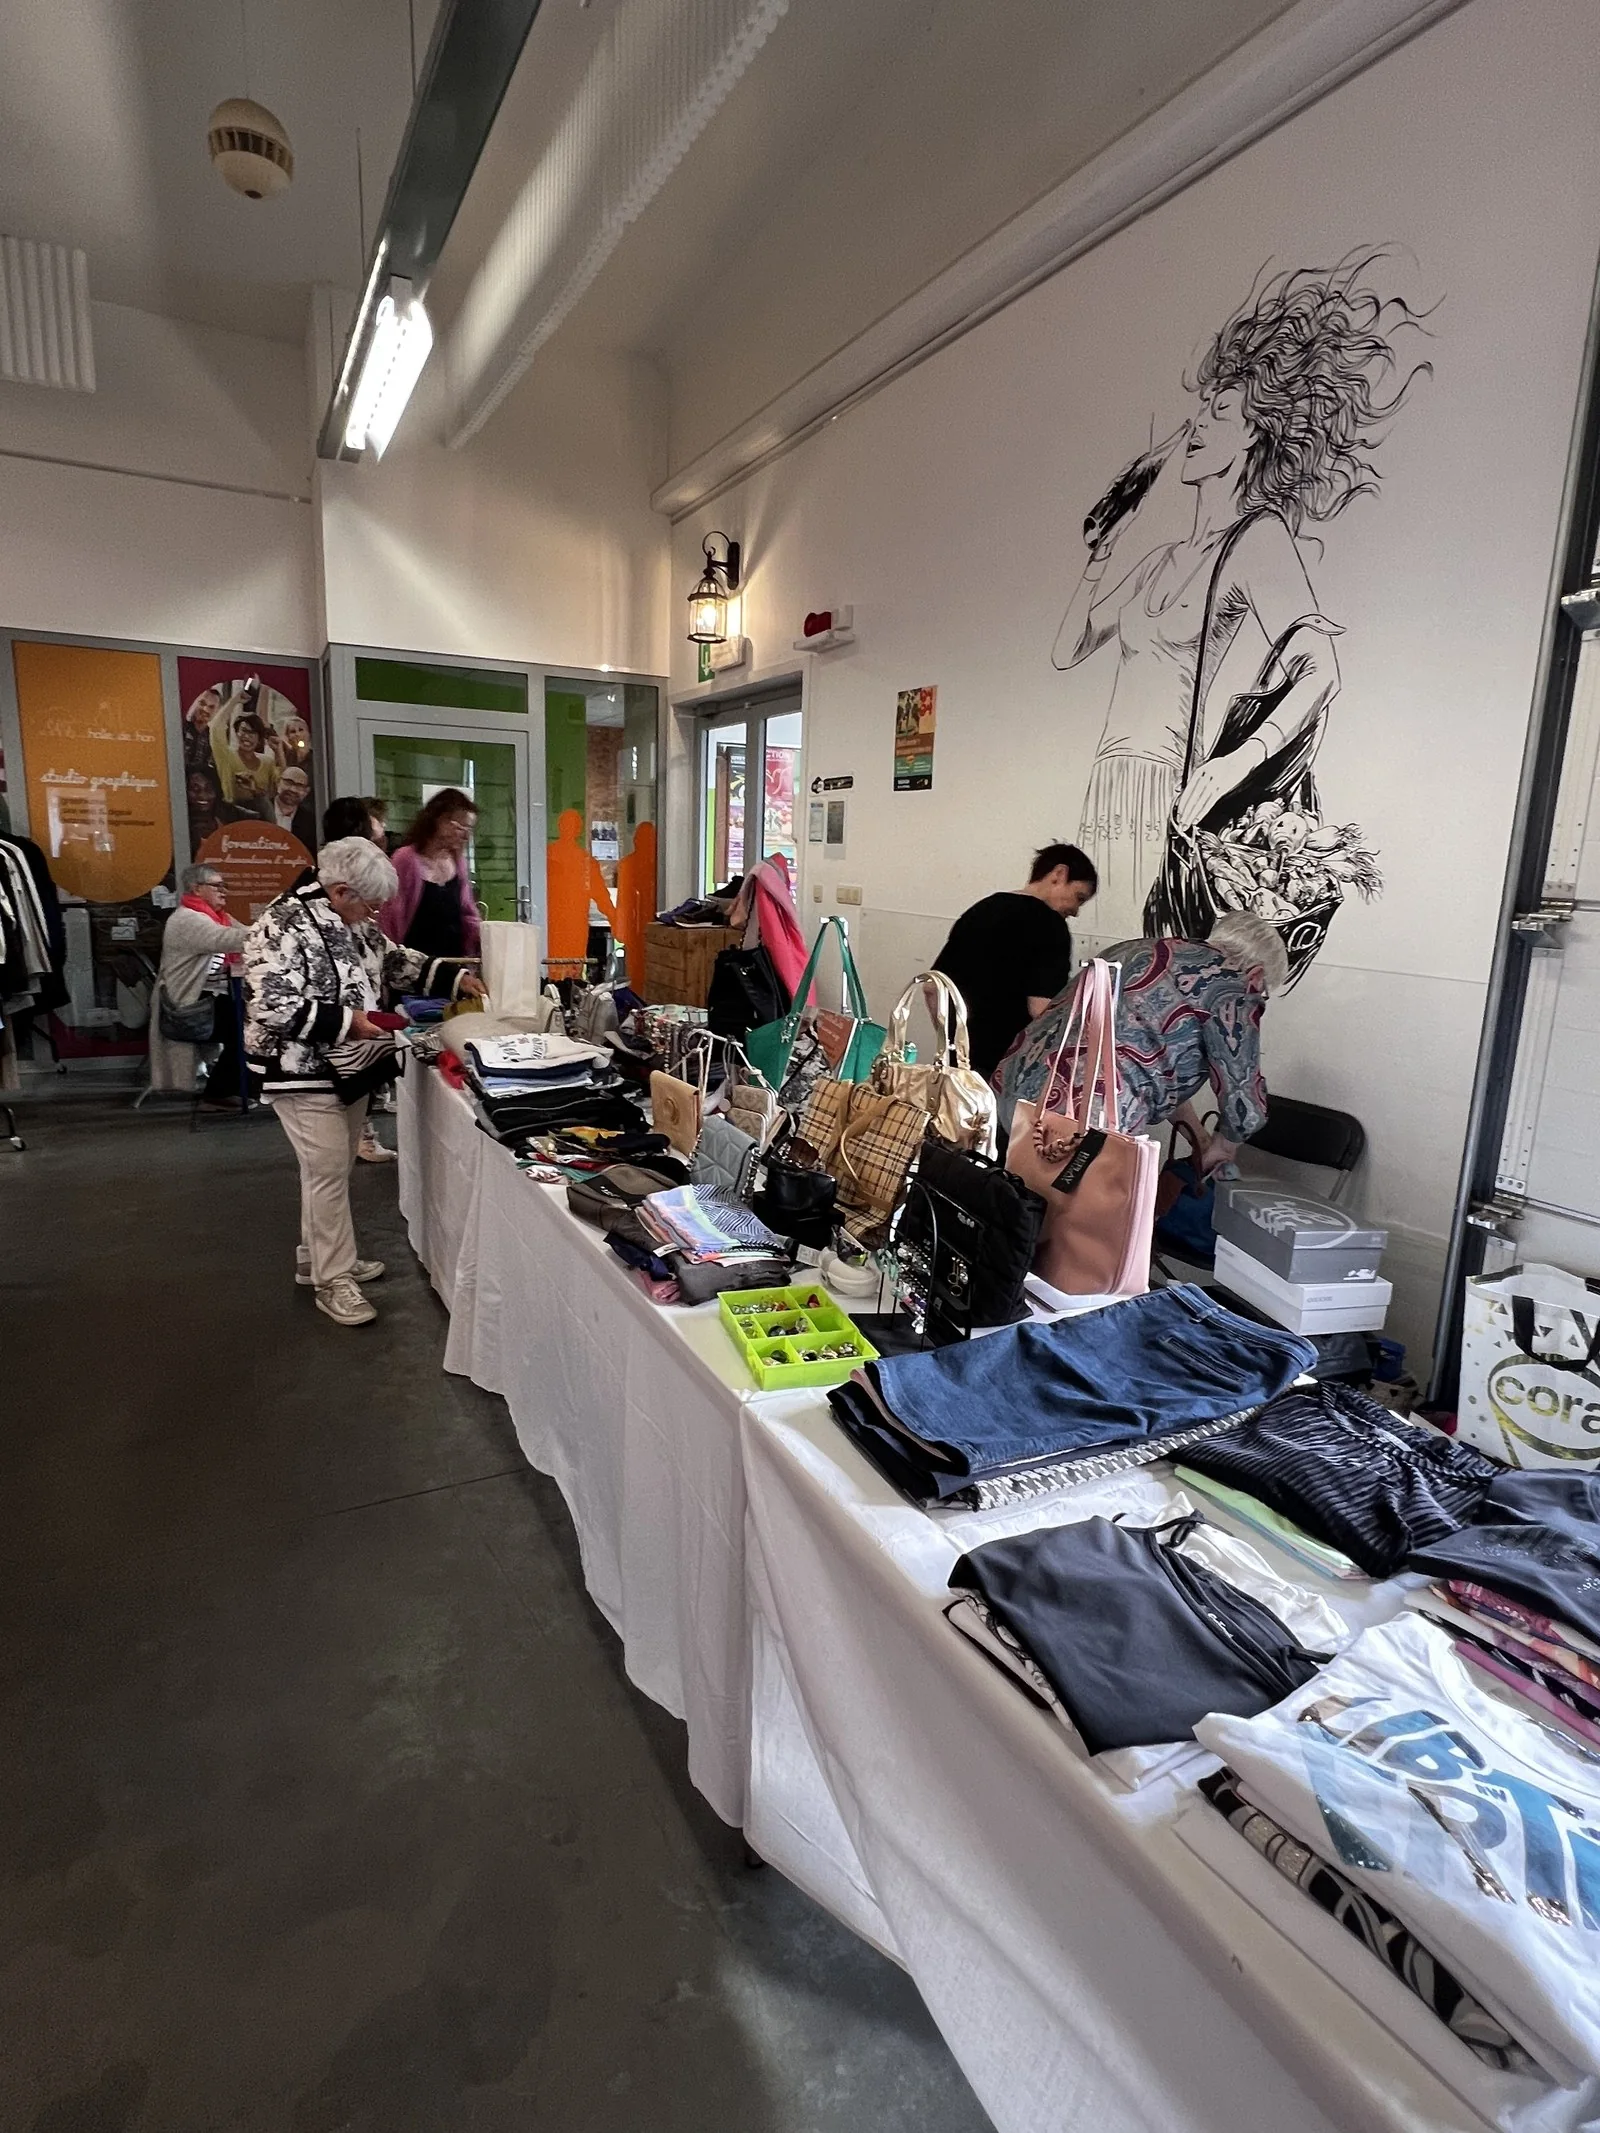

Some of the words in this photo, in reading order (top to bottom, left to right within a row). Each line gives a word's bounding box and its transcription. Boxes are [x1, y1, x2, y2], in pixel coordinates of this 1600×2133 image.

[89, 771, 158, 793] graphique
[222, 835, 291, 853] formations
[1495, 1376, 1600, 1434] cora
